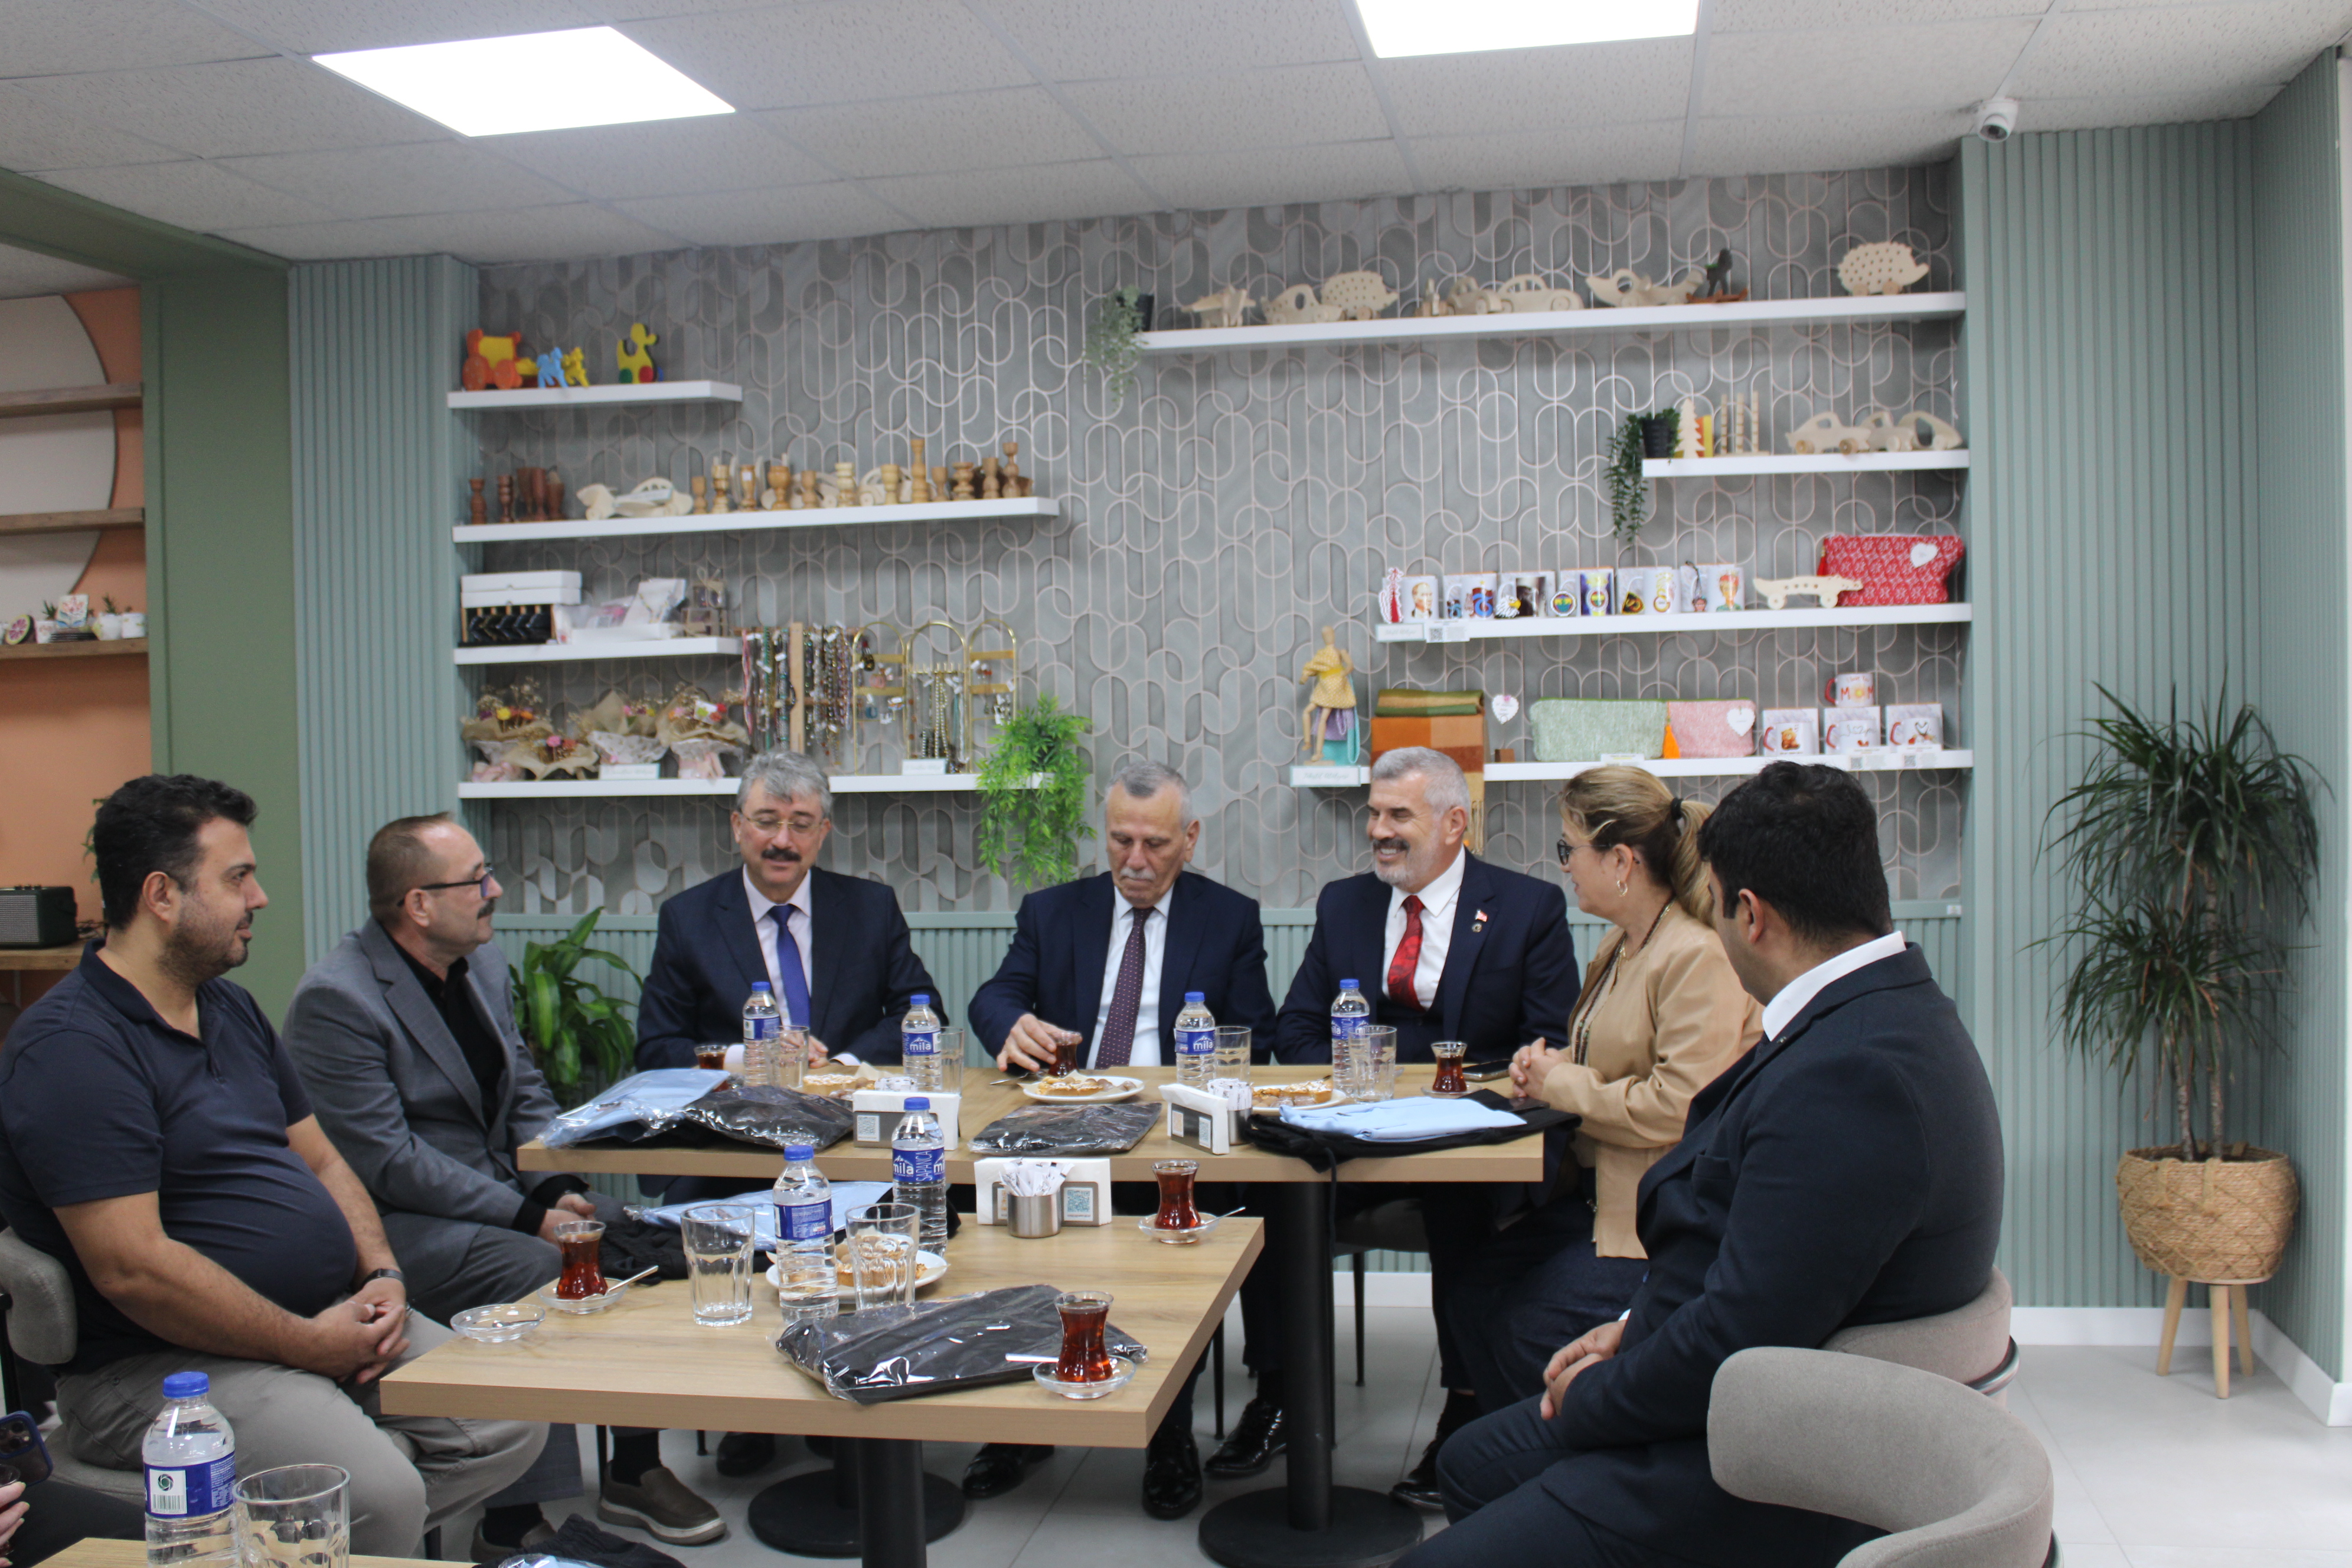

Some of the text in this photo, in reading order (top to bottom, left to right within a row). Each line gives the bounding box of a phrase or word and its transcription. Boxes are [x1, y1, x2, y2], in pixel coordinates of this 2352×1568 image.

[910, 1042, 931, 1051] mila
[1193, 1040, 1213, 1050] mila
[915, 1150, 933, 1181] SAPANCA
